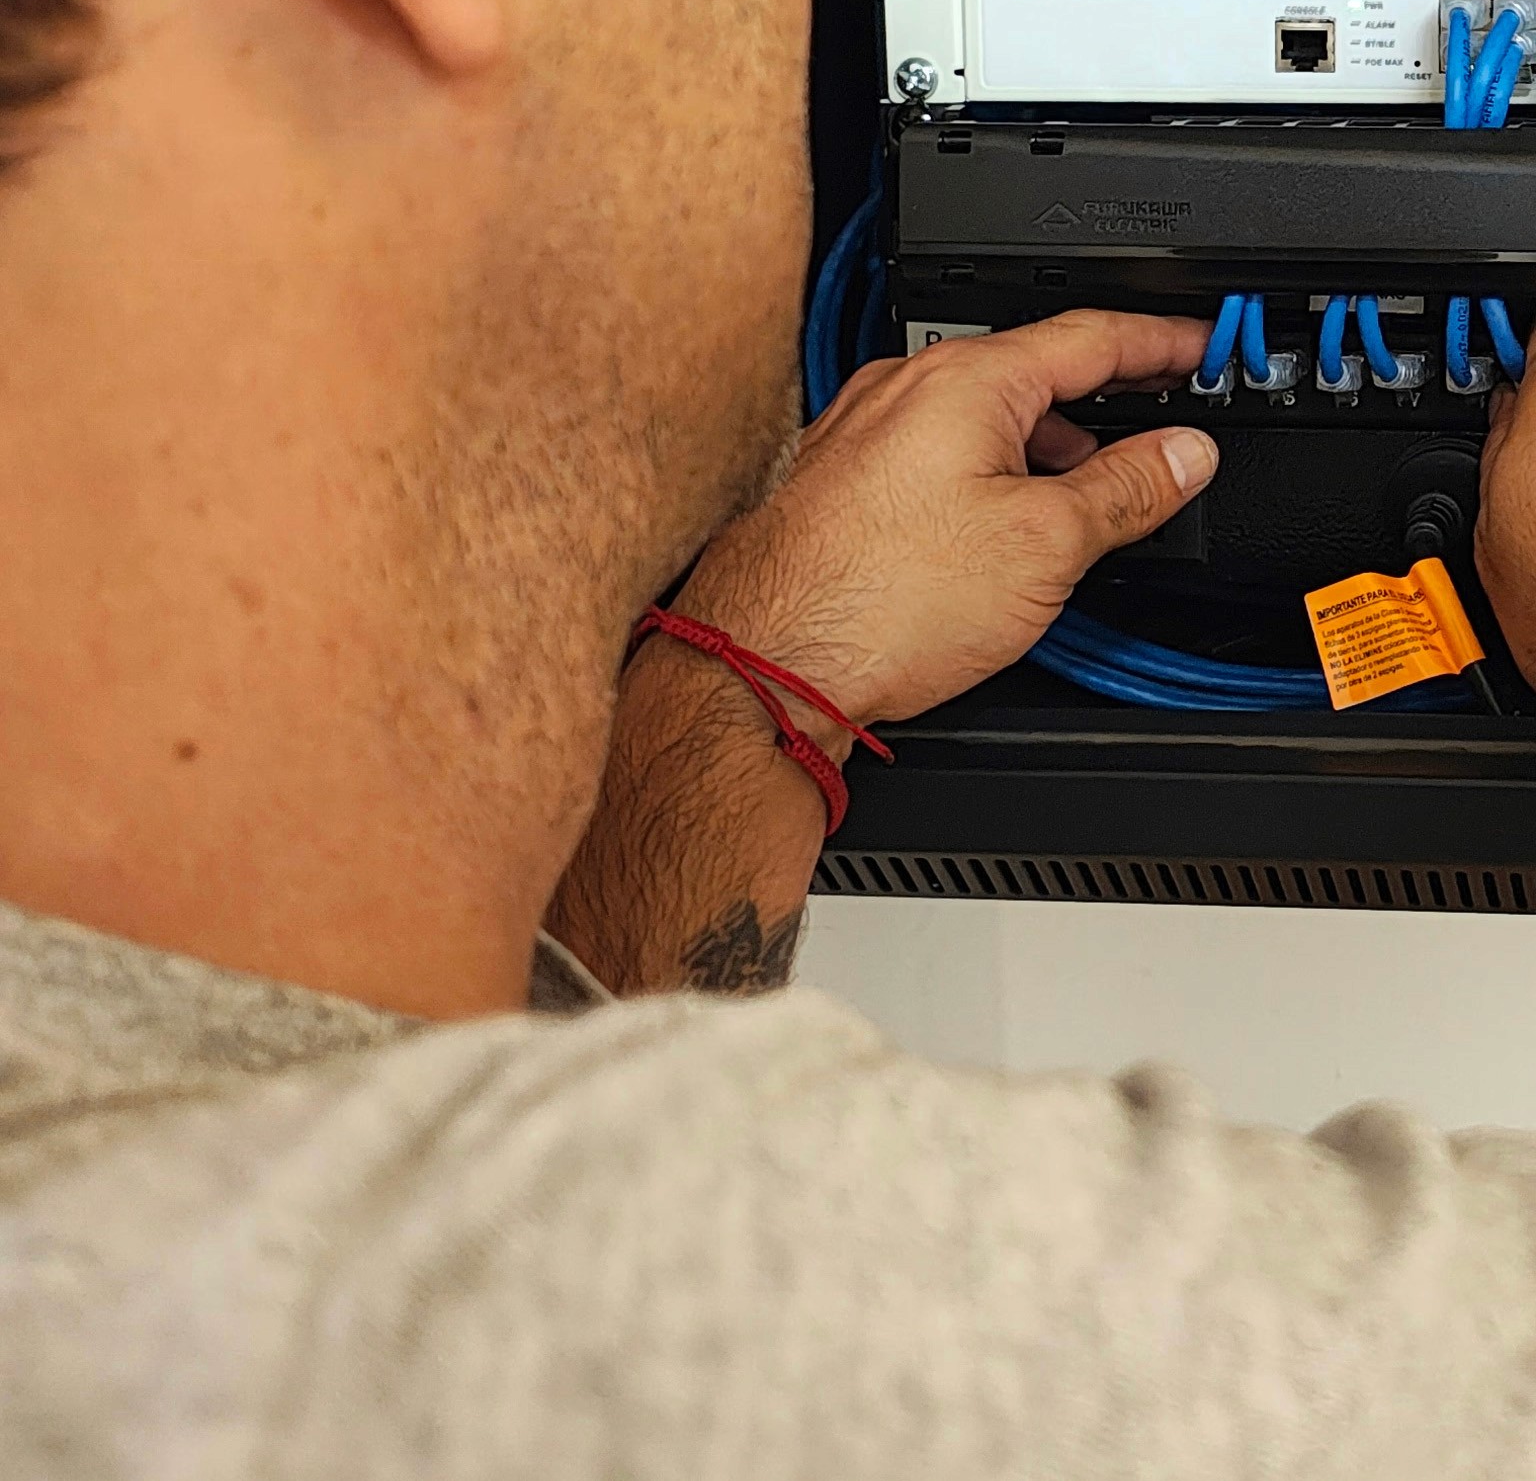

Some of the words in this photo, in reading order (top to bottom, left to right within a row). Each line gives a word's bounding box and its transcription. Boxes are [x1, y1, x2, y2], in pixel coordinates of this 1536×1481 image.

[1364, 0, 1384, 10] PWR
[1364, 20, 1396, 29] ALARM
[1364, 40, 1396, 48] BT/BLE
[1365, 58, 1382, 66] POE
[1384, 58, 1404, 66] MAX
[1404, 72, 1433, 81] RESET
[1316, 593, 1367, 620] IMPORTANTE
[1367, 588, 1388, 601] PARA
[1330, 660, 1342, 670] NO
[1342, 656, 1354, 666] LA
